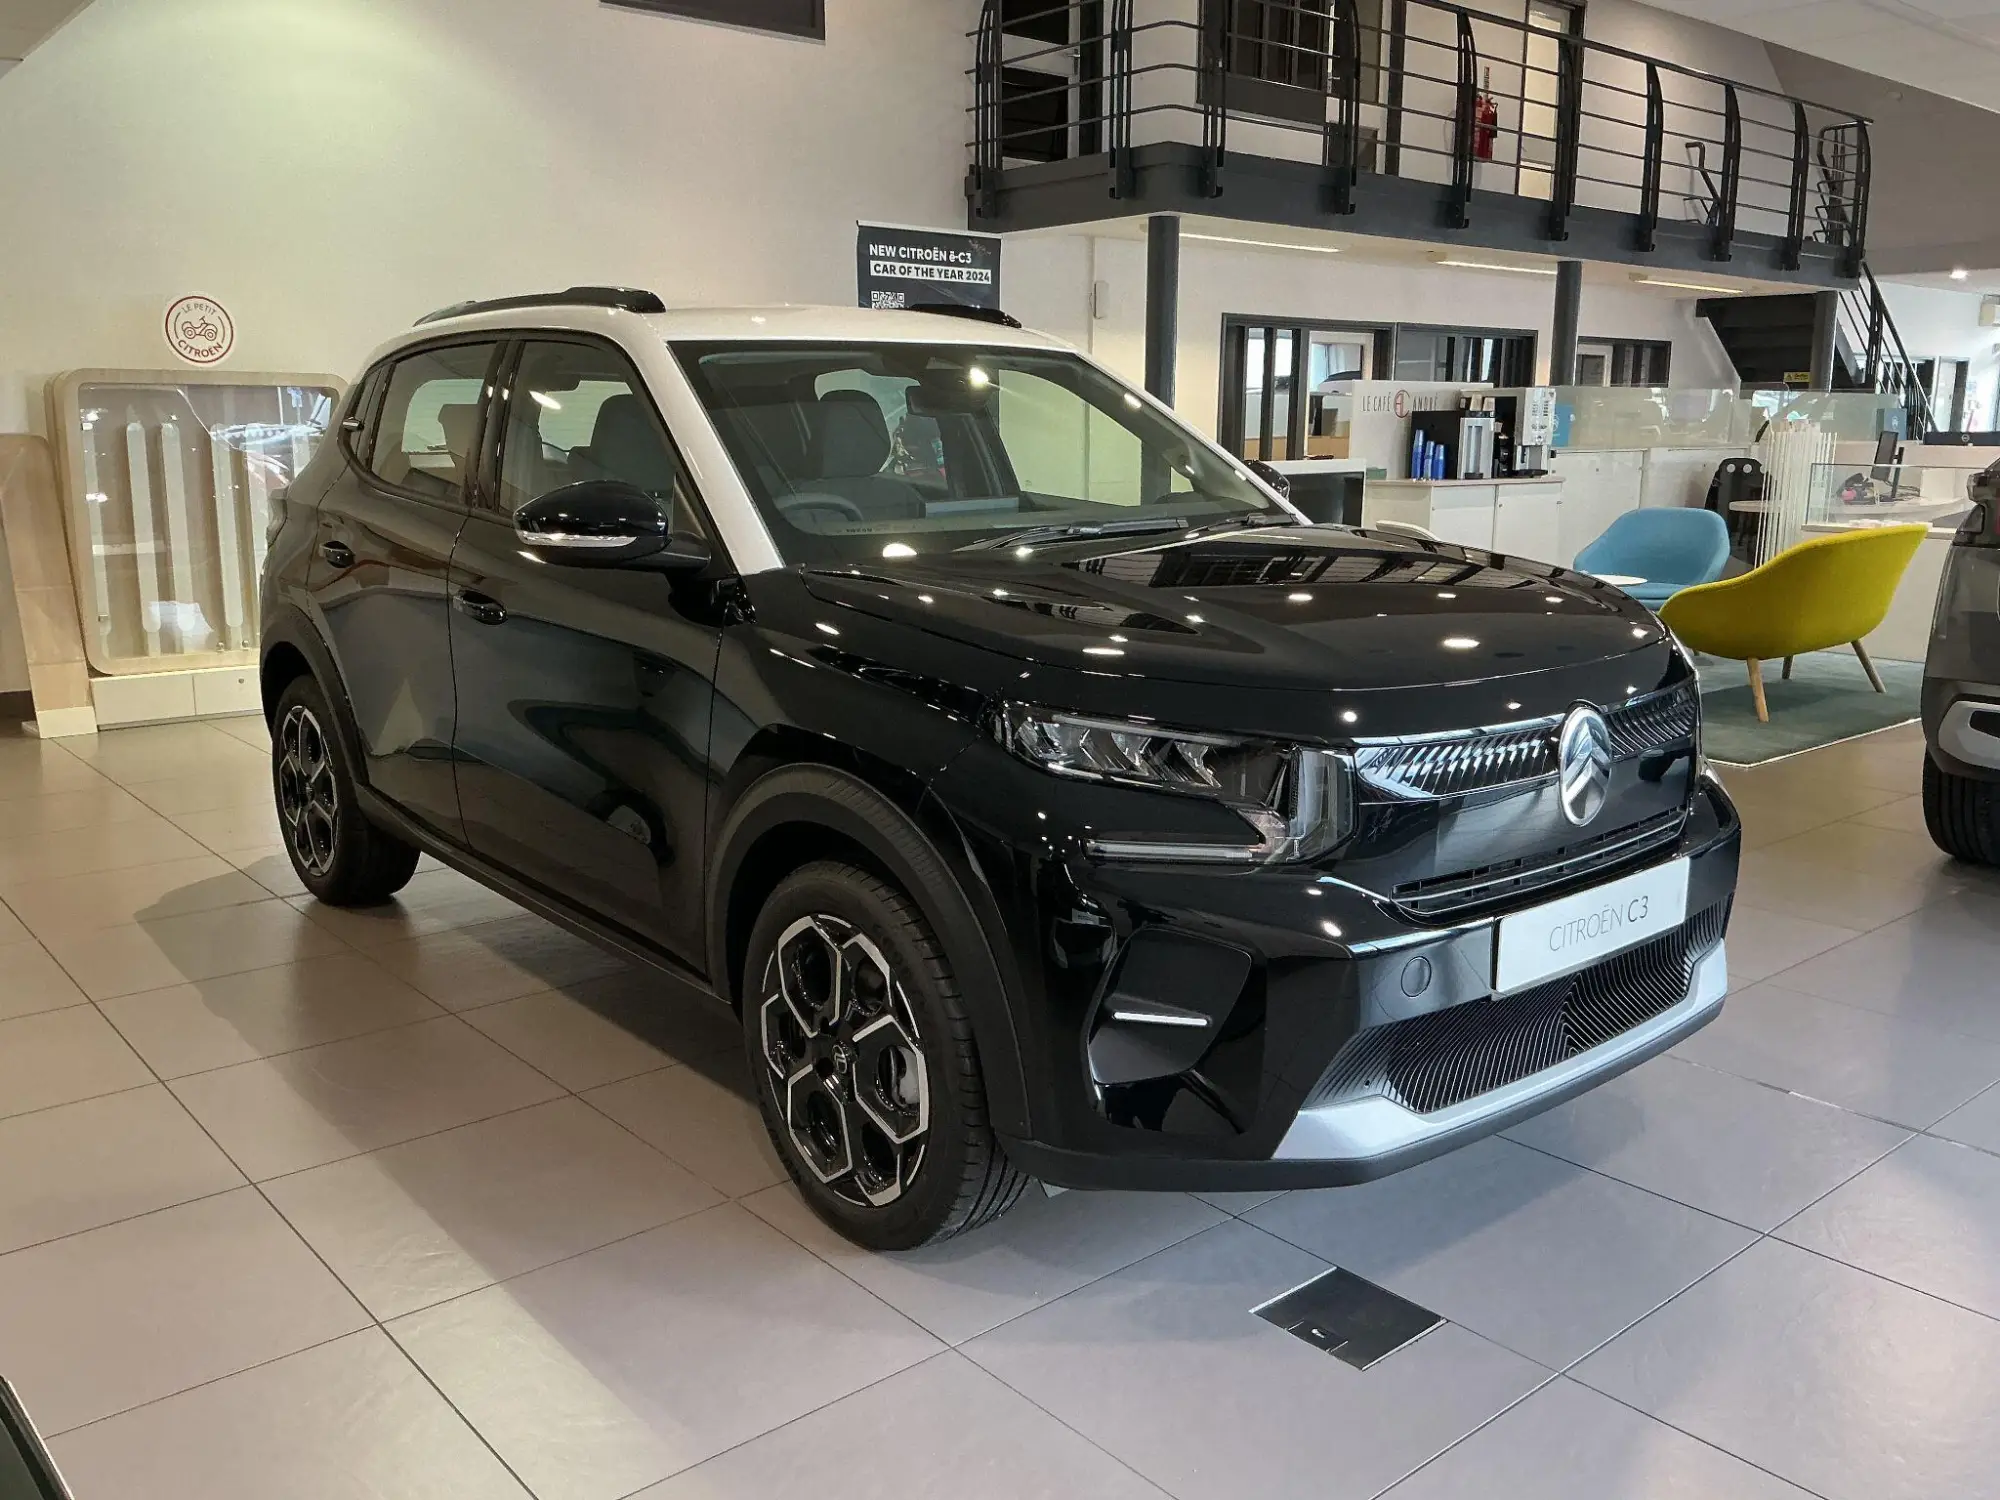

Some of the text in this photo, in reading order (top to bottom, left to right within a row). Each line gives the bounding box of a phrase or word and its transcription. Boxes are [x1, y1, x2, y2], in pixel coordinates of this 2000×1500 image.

[869, 244, 896, 257] NEW
[899, 247, 946, 261] CITROËN
[874, 263, 989, 281] CAR OF THE YEAR 2024
[182, 303, 216, 315] LE PETIT
[1362, 395, 1371, 412] LE
[1373, 391, 1391, 412] CAFÉ
[1550, 895, 1649, 951] CITROËN C3
